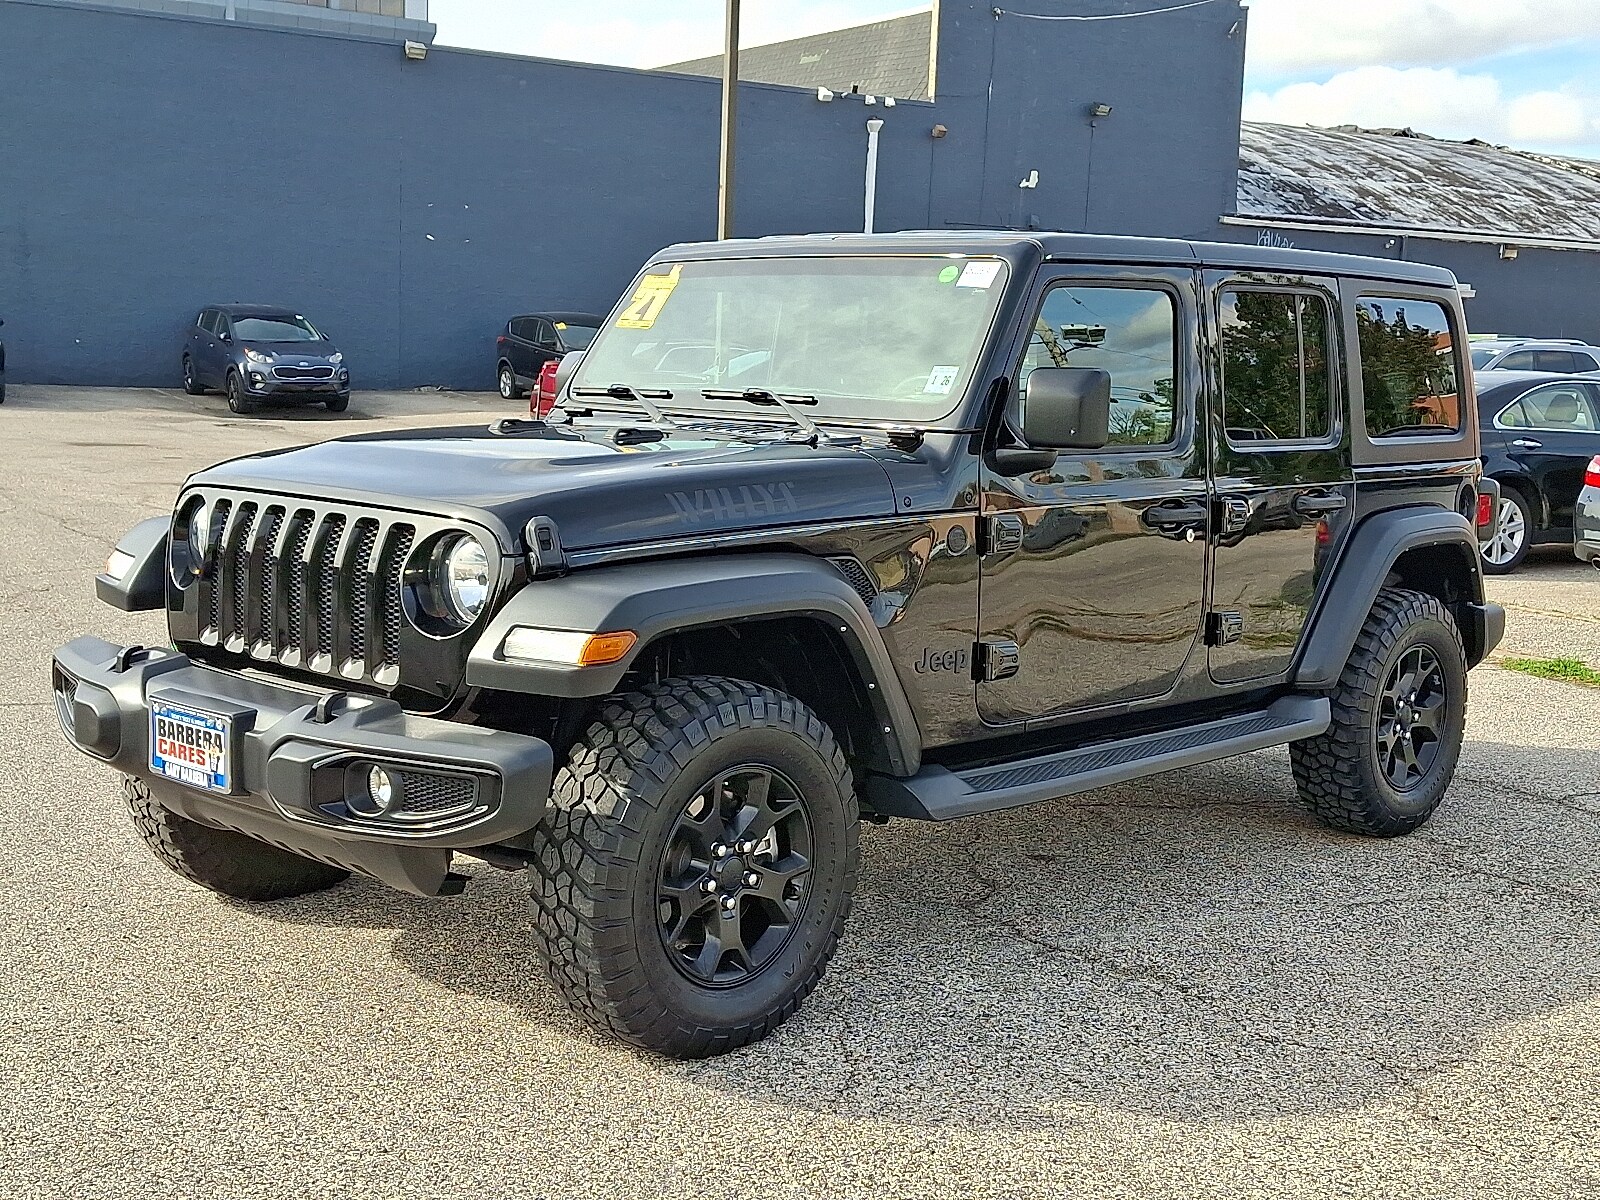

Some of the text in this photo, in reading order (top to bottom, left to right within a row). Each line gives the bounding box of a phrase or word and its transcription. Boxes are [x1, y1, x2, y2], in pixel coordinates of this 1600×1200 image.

[940, 375, 952, 386] 26
[664, 481, 799, 523] WILLYS
[914, 647, 968, 674] Jeep
[157, 718, 223, 754] BARBERA
[157, 738, 206, 767] CARES
